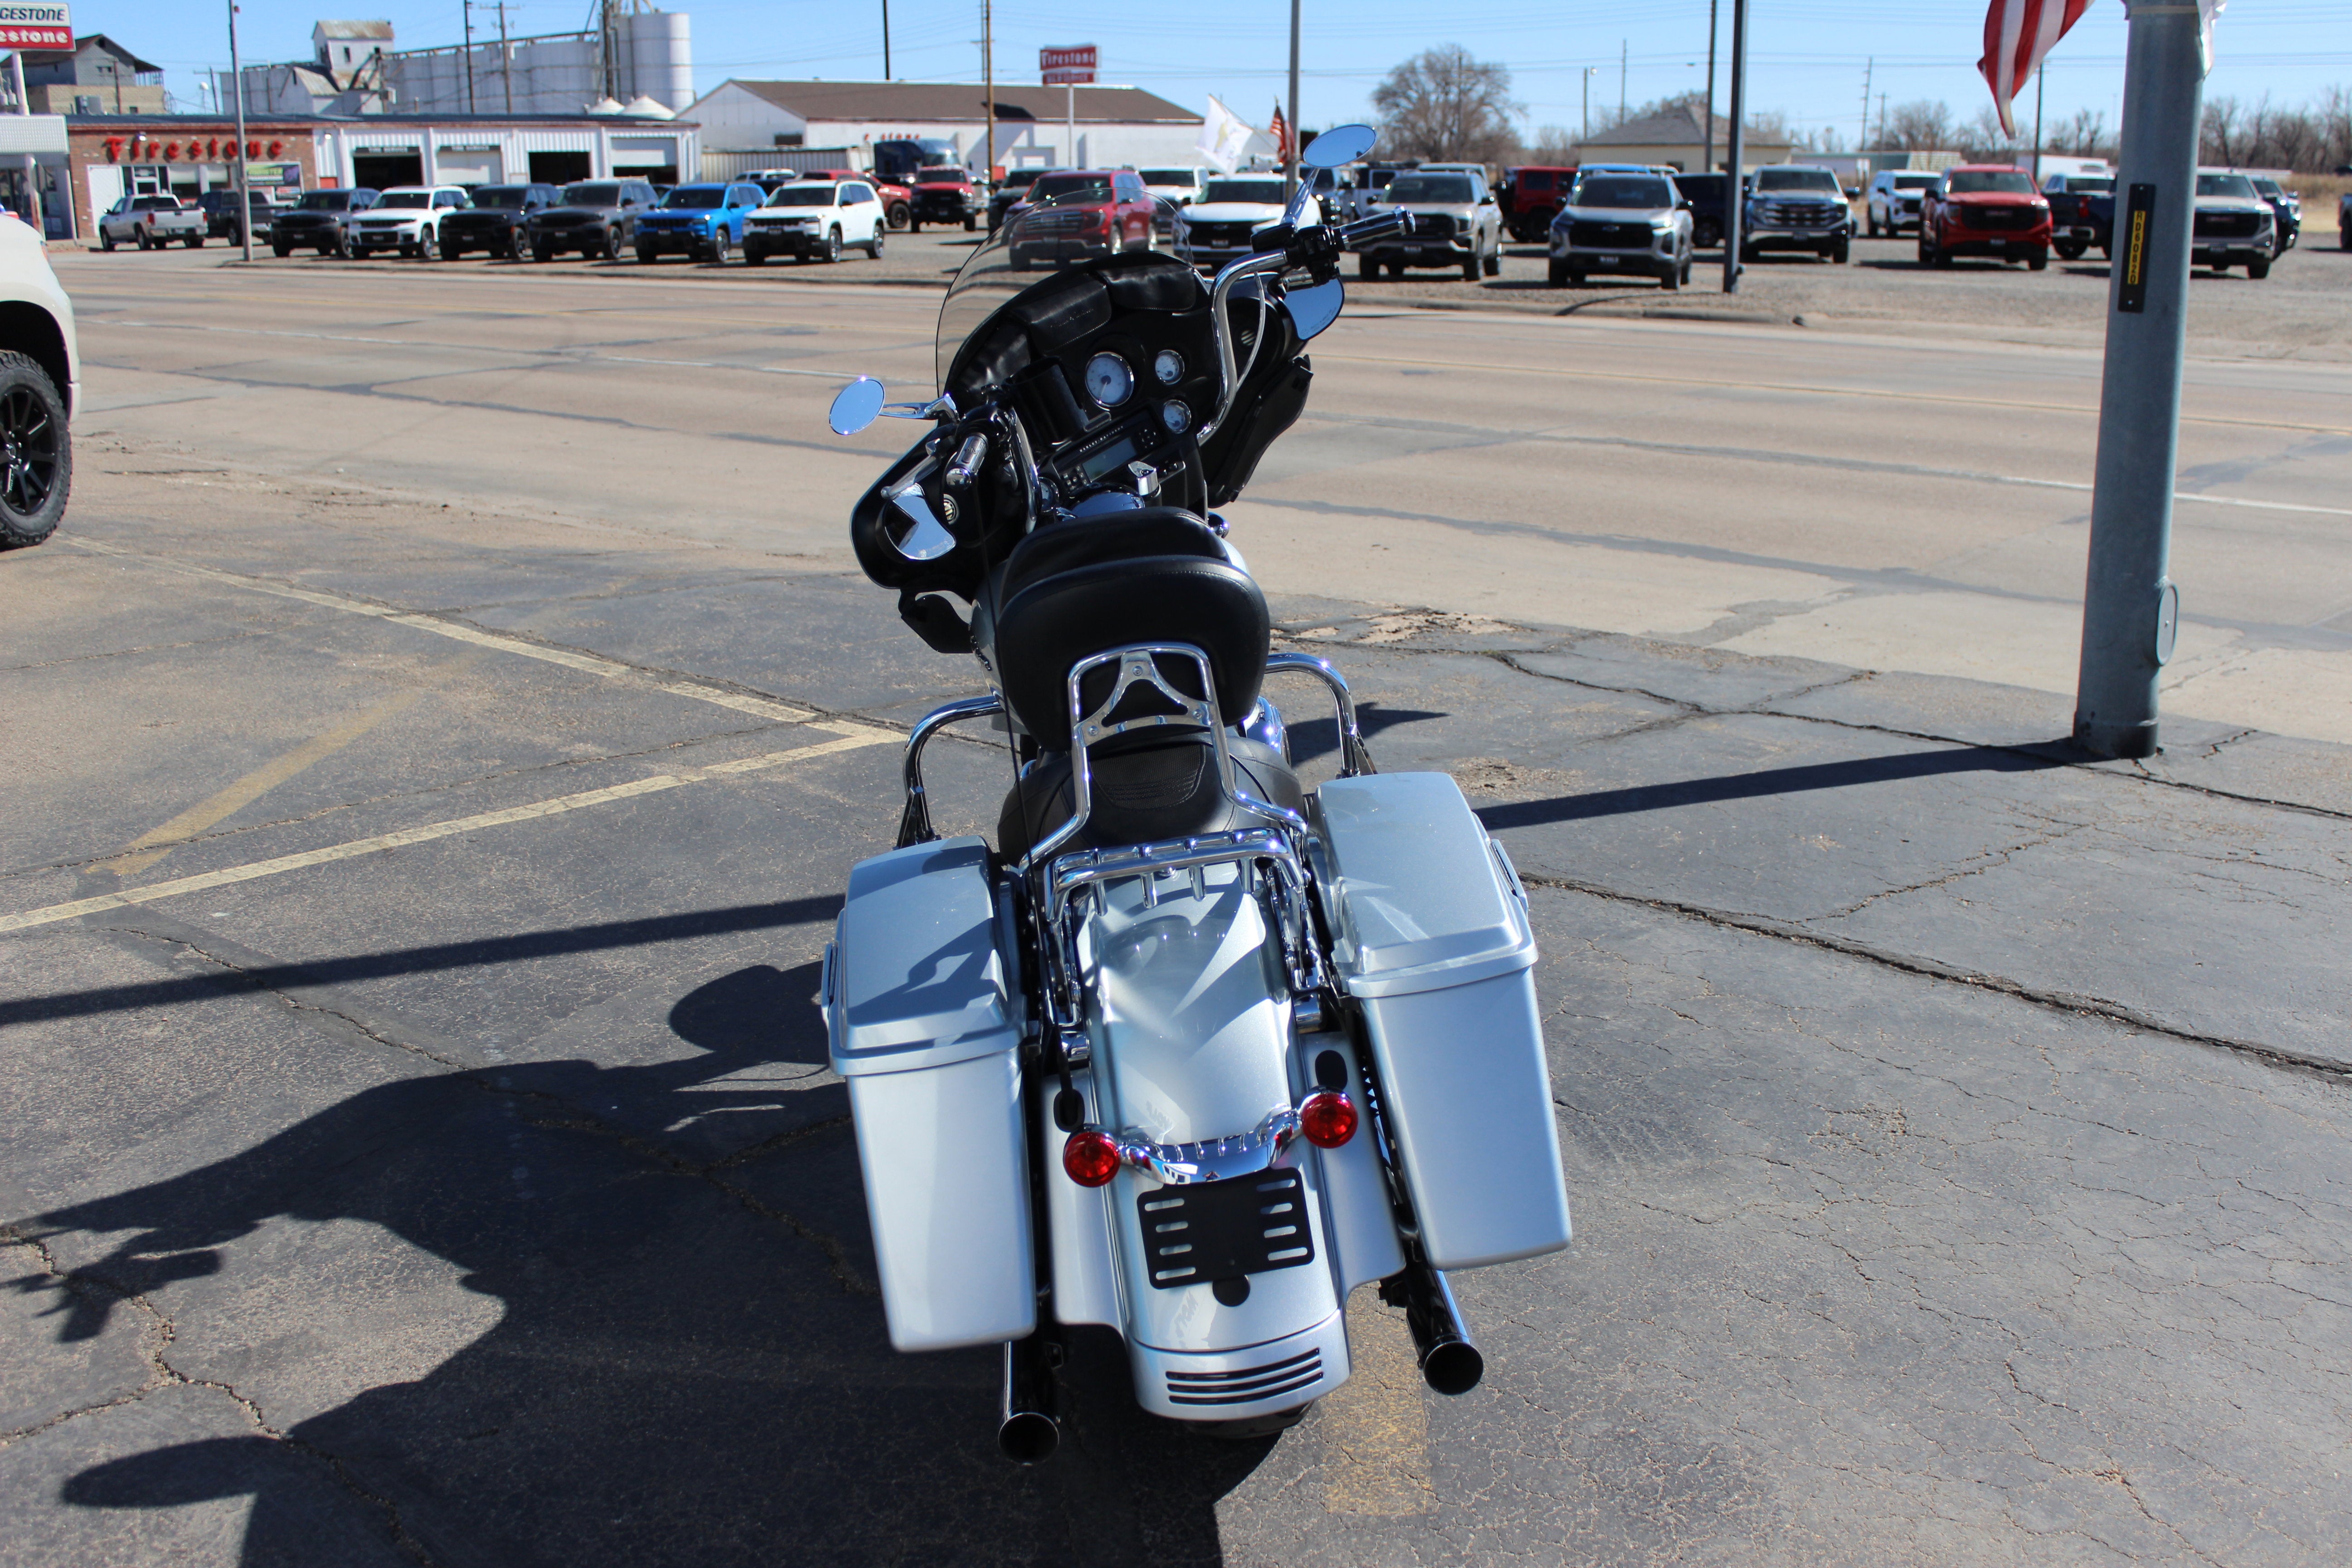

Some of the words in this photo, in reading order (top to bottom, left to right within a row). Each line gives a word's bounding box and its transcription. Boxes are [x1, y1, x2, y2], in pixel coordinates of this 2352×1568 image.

[0, 8, 65, 21] GESTONE
[1041, 51, 1095, 67] Firestone
[103, 136, 283, 162] Firestone
